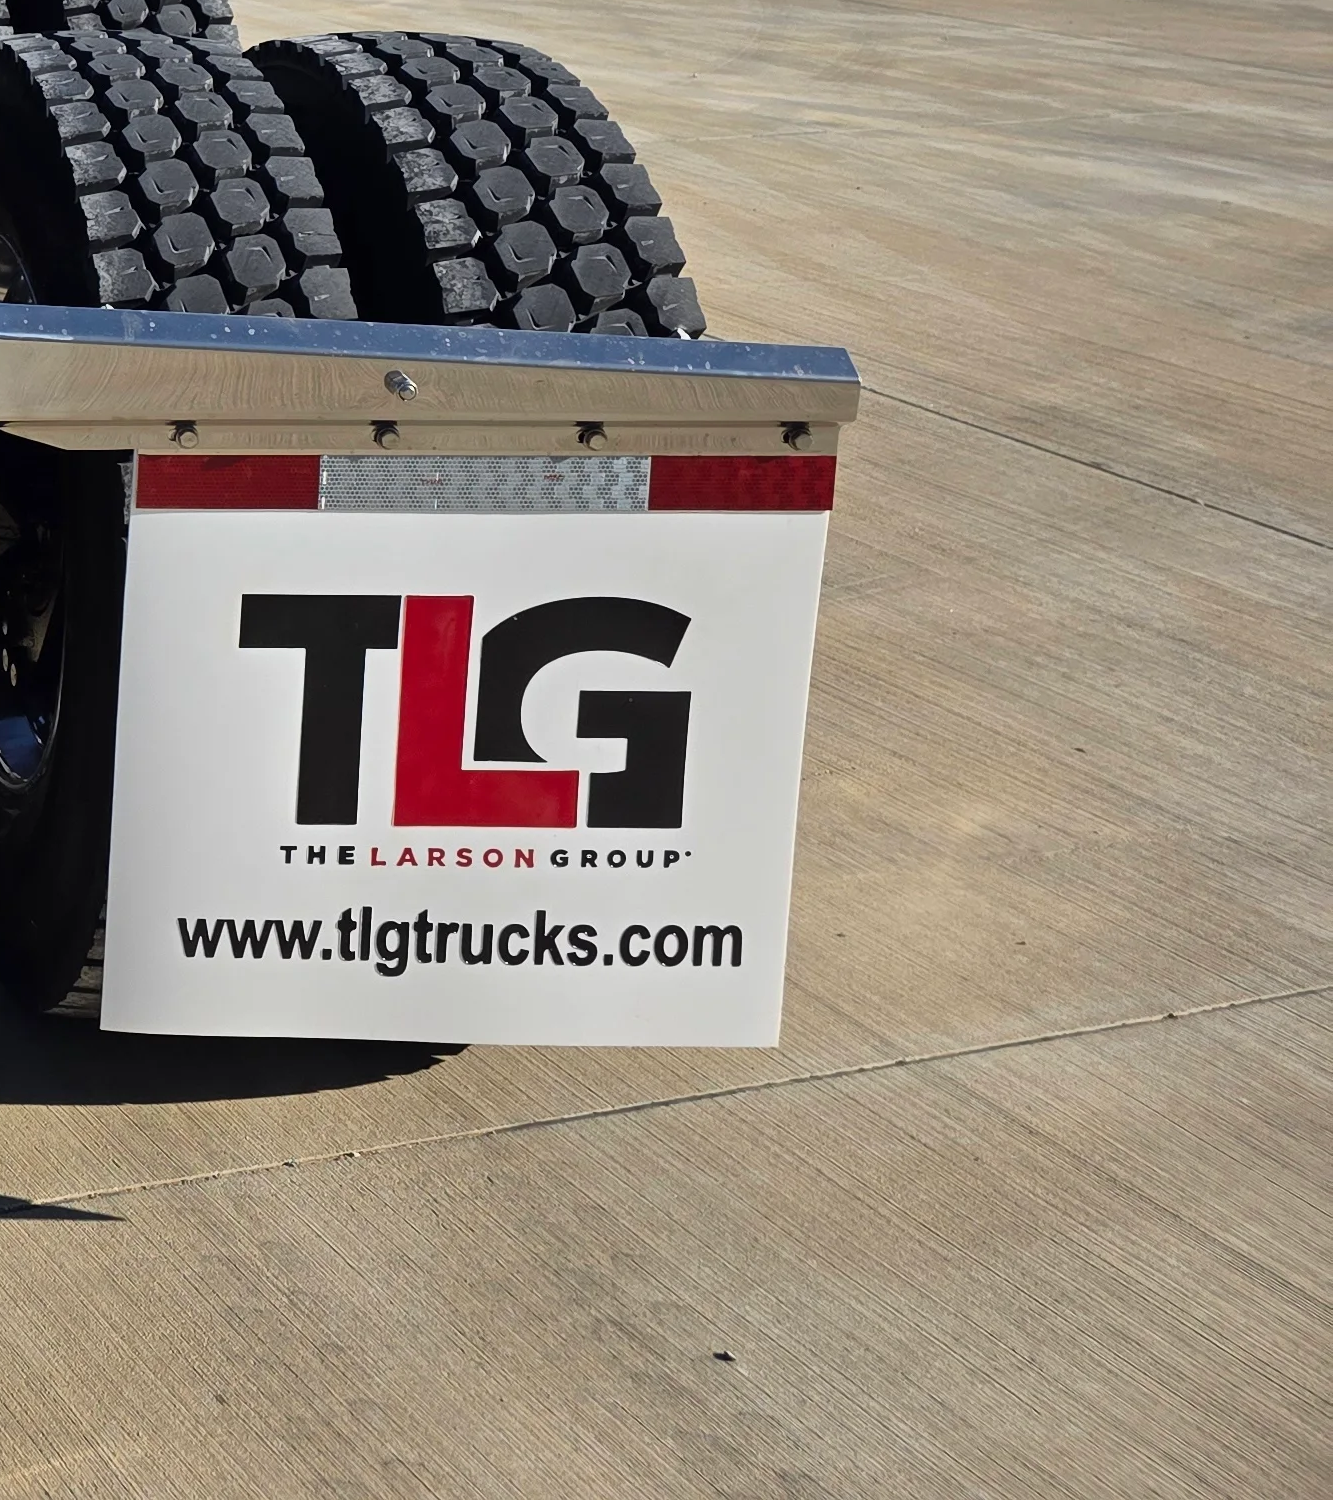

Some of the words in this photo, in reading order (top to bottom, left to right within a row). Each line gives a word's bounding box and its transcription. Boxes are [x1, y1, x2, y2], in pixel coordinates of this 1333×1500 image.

[238, 593, 692, 829] TLG
[279, 845, 357, 866] THE
[370, 847, 536, 869] LARSON
[550, 849, 681, 869] GROUP
[177, 906, 743, 978] www.tlgtrucks.com
